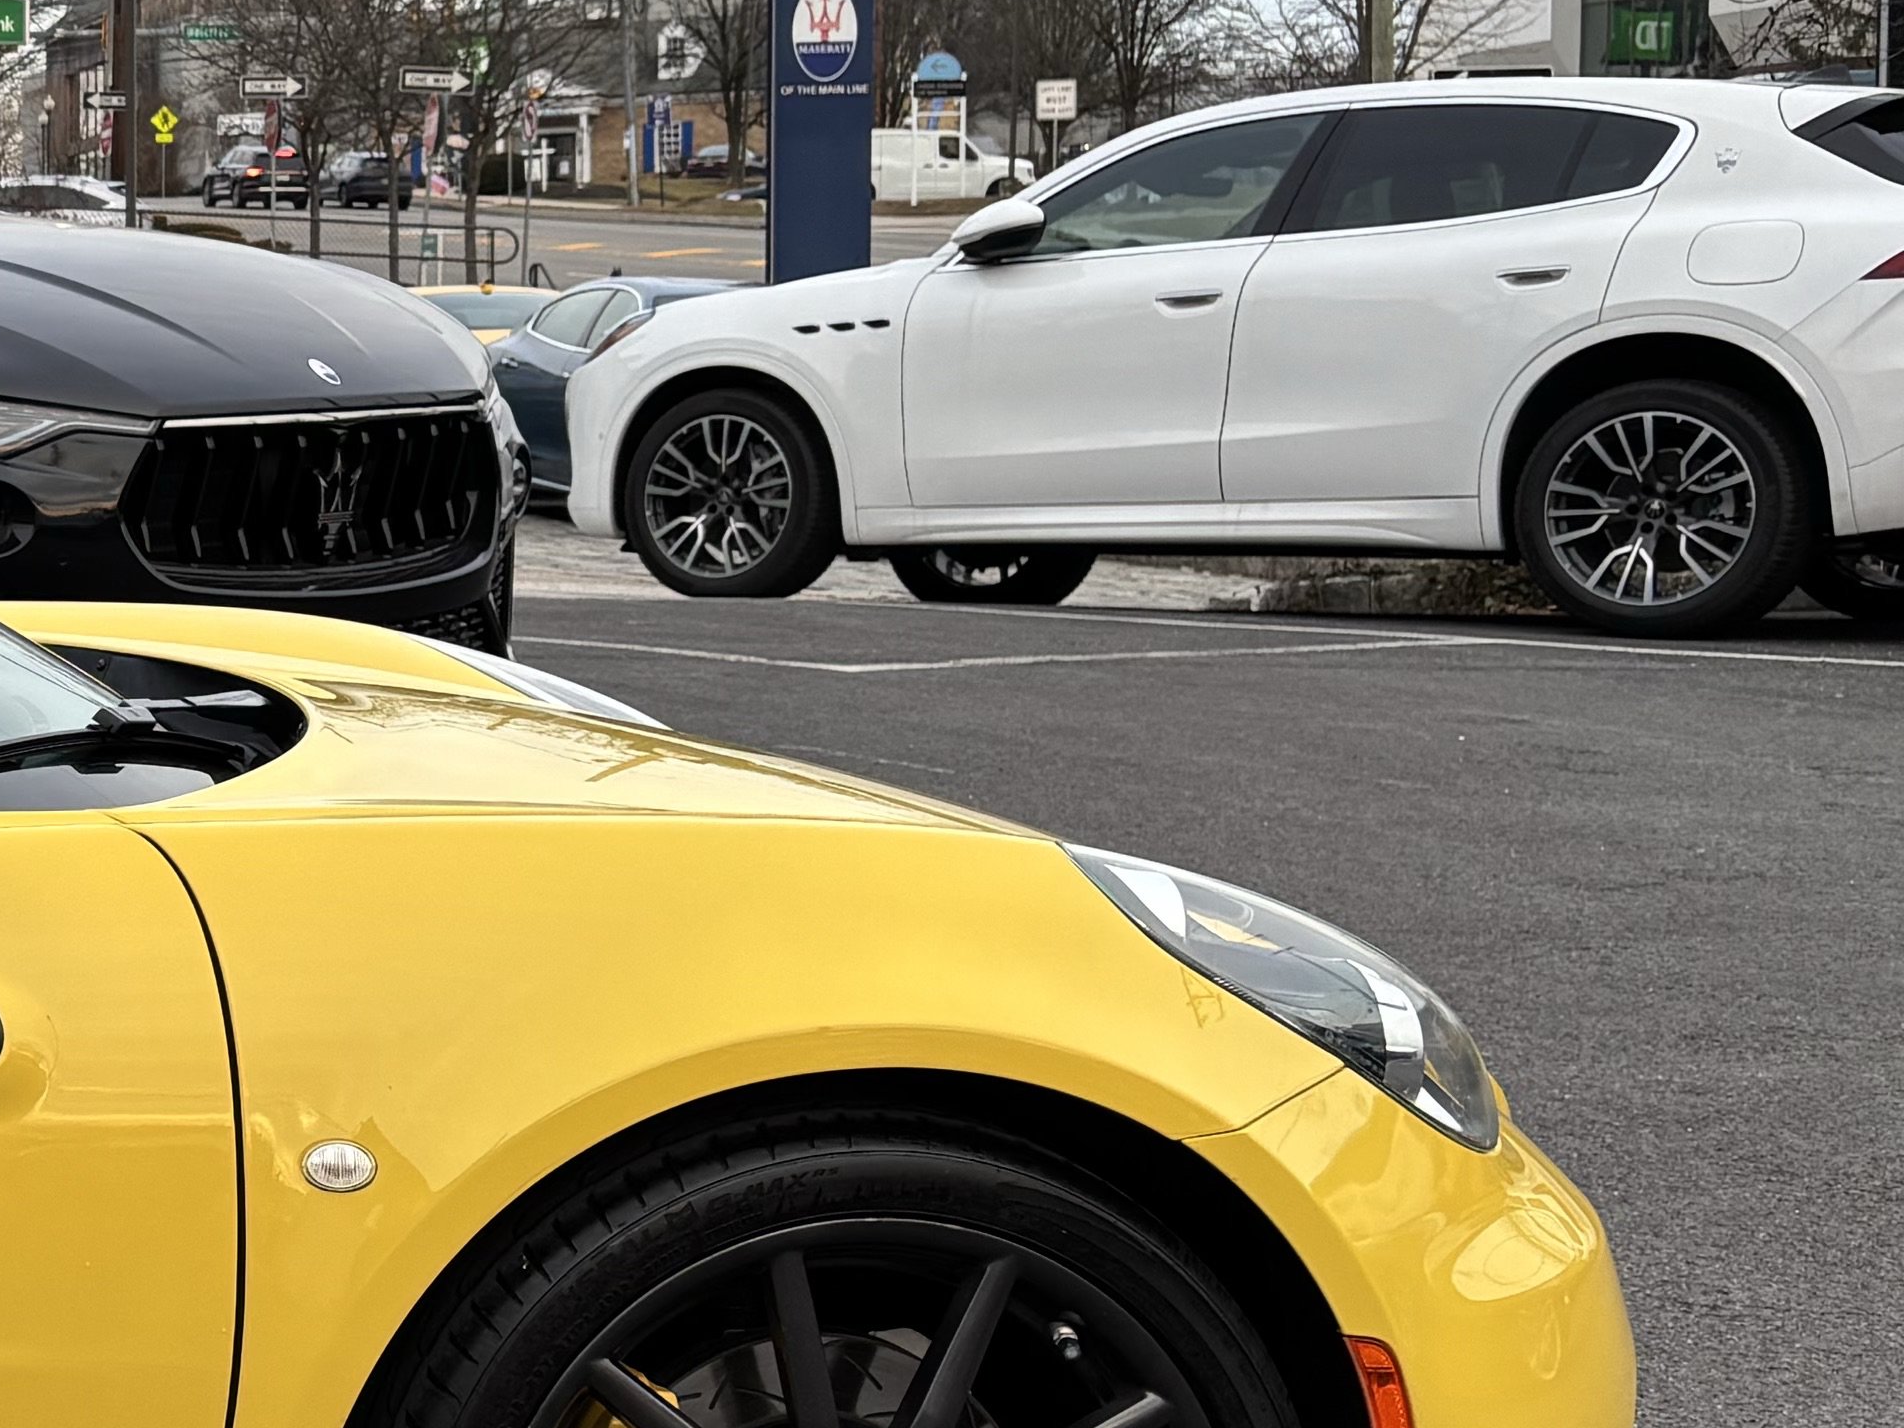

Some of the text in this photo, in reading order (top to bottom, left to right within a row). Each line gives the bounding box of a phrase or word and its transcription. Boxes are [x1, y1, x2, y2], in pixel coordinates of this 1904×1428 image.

[799, 43, 850, 54] MASERATI
[780, 82, 870, 96] OF THE MAIN LINE
